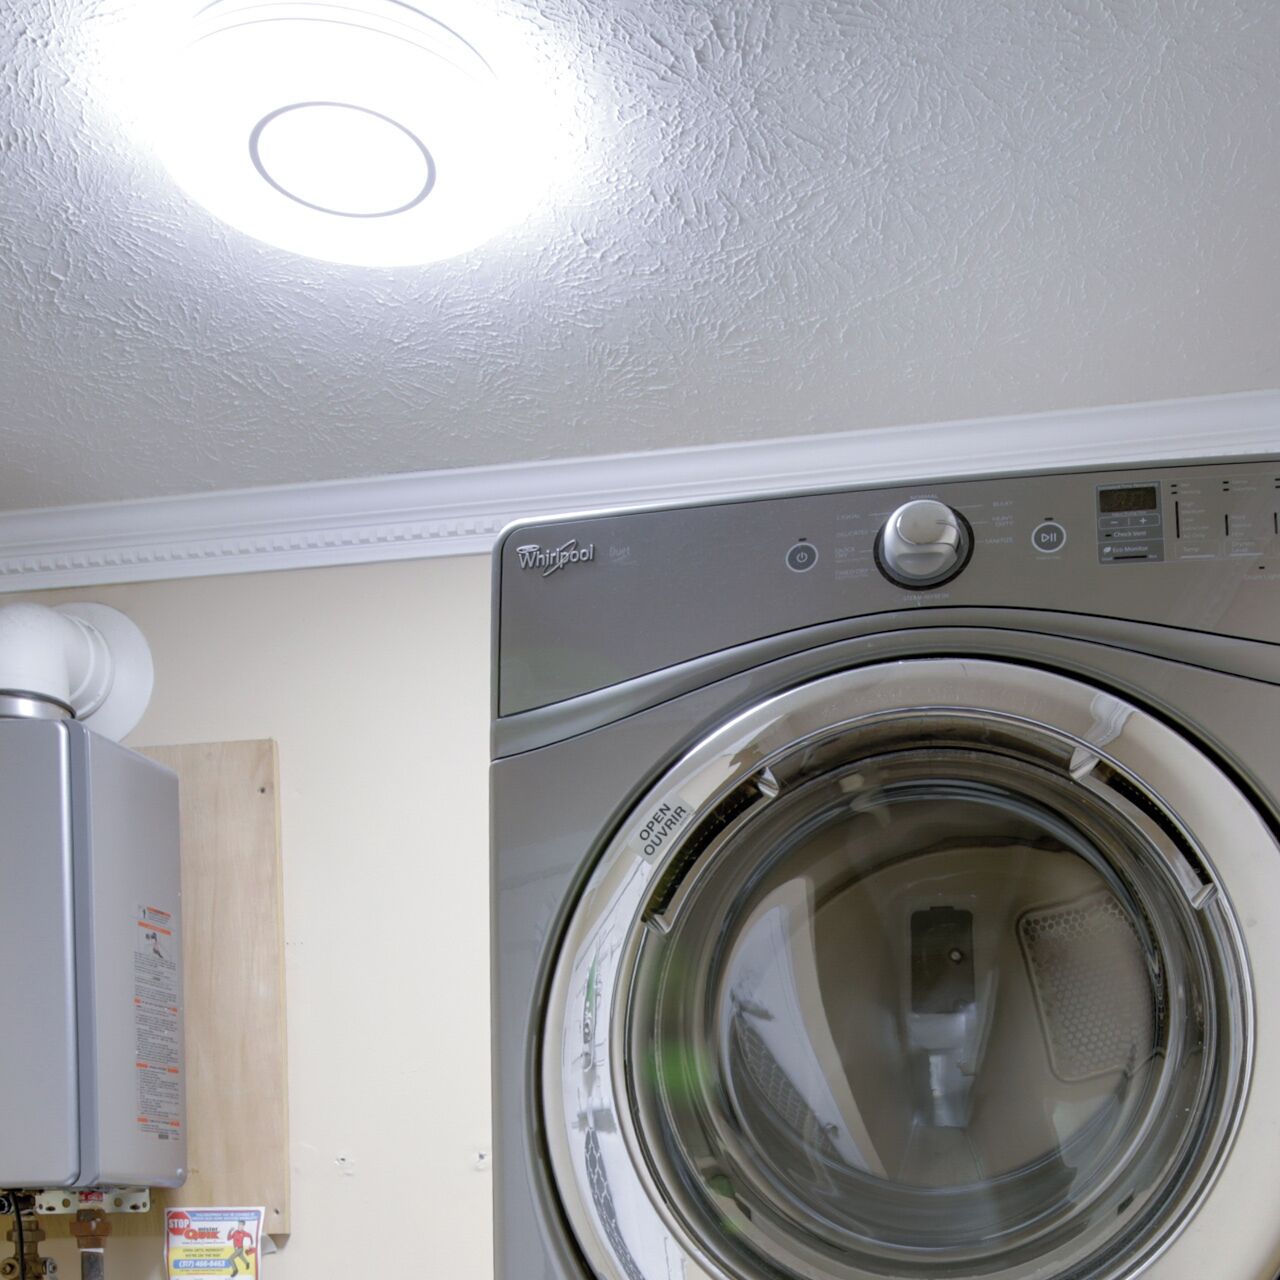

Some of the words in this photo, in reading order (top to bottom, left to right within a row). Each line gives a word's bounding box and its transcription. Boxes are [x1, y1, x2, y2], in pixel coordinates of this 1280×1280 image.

[518, 543, 594, 569] Whirlpool
[640, 803, 671, 841] OPEN
[644, 806, 686, 856] OUVRIR
[169, 1219, 189, 1228] STOP
